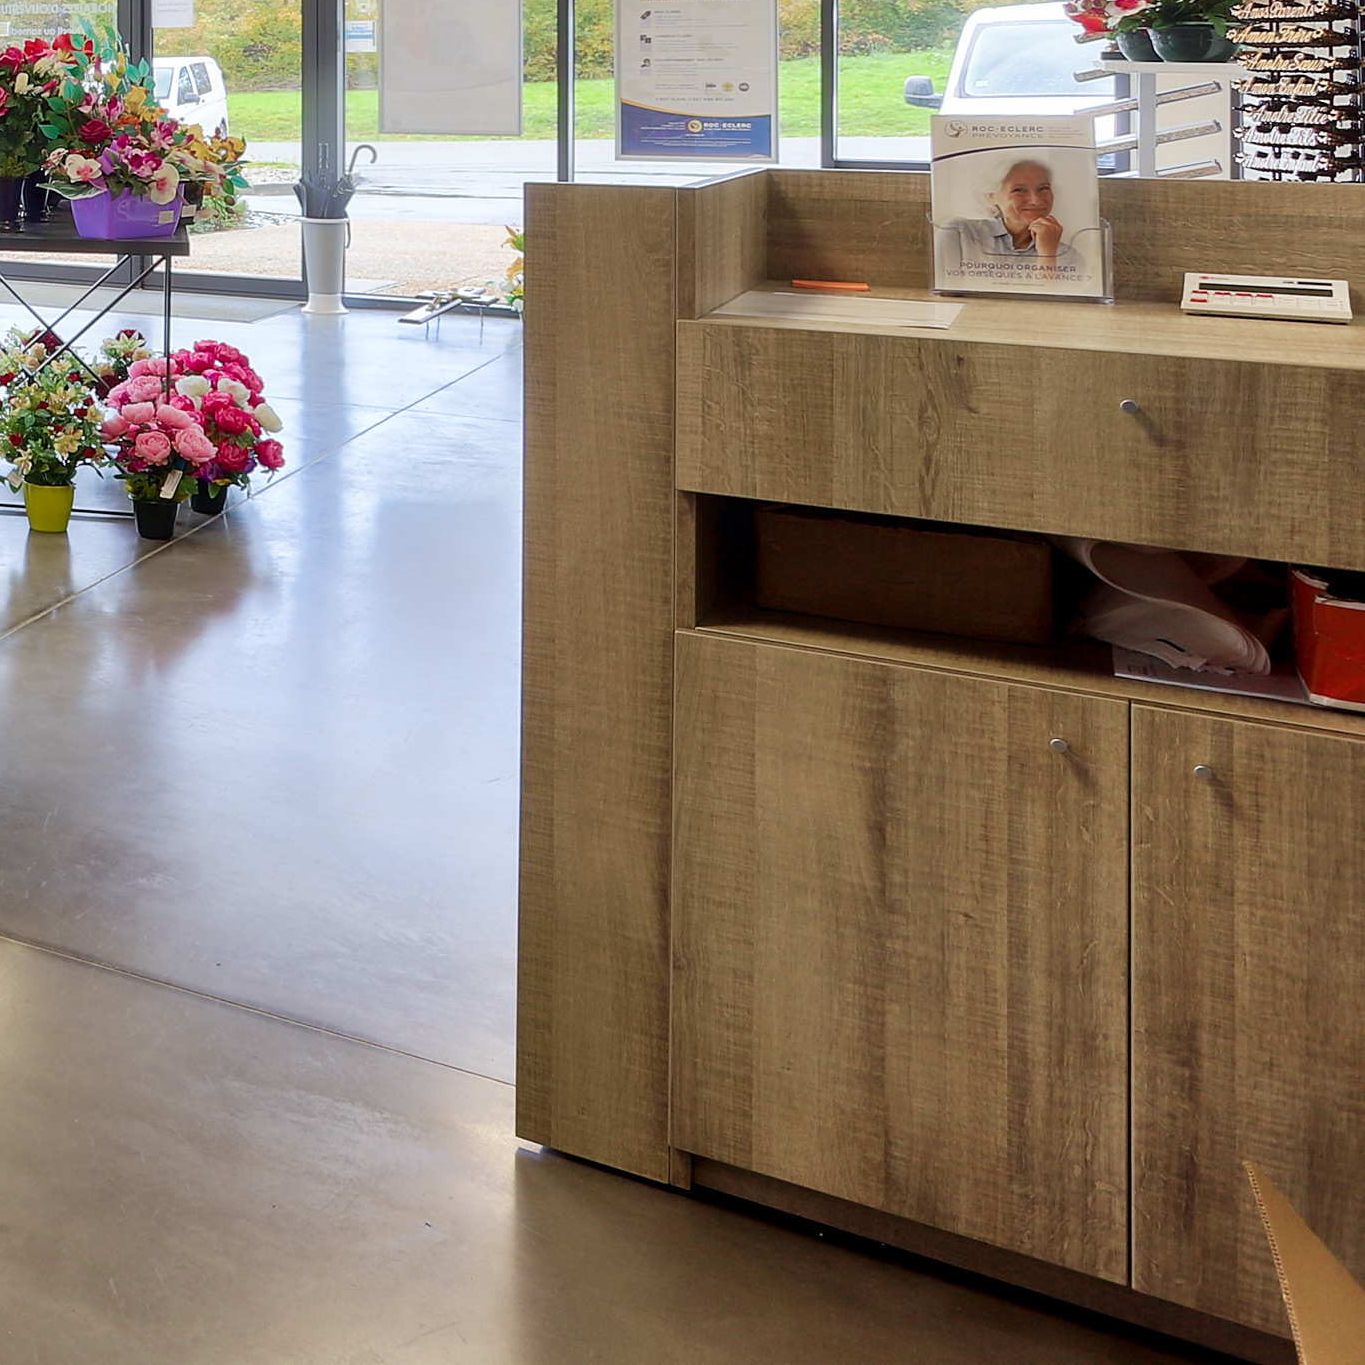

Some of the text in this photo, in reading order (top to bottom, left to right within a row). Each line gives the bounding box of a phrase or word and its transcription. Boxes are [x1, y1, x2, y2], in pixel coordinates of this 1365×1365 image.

[960, 262, 1077, 273] POURQUOI ORGANISER
[1035, 273, 1083, 282] L'AVANCE
